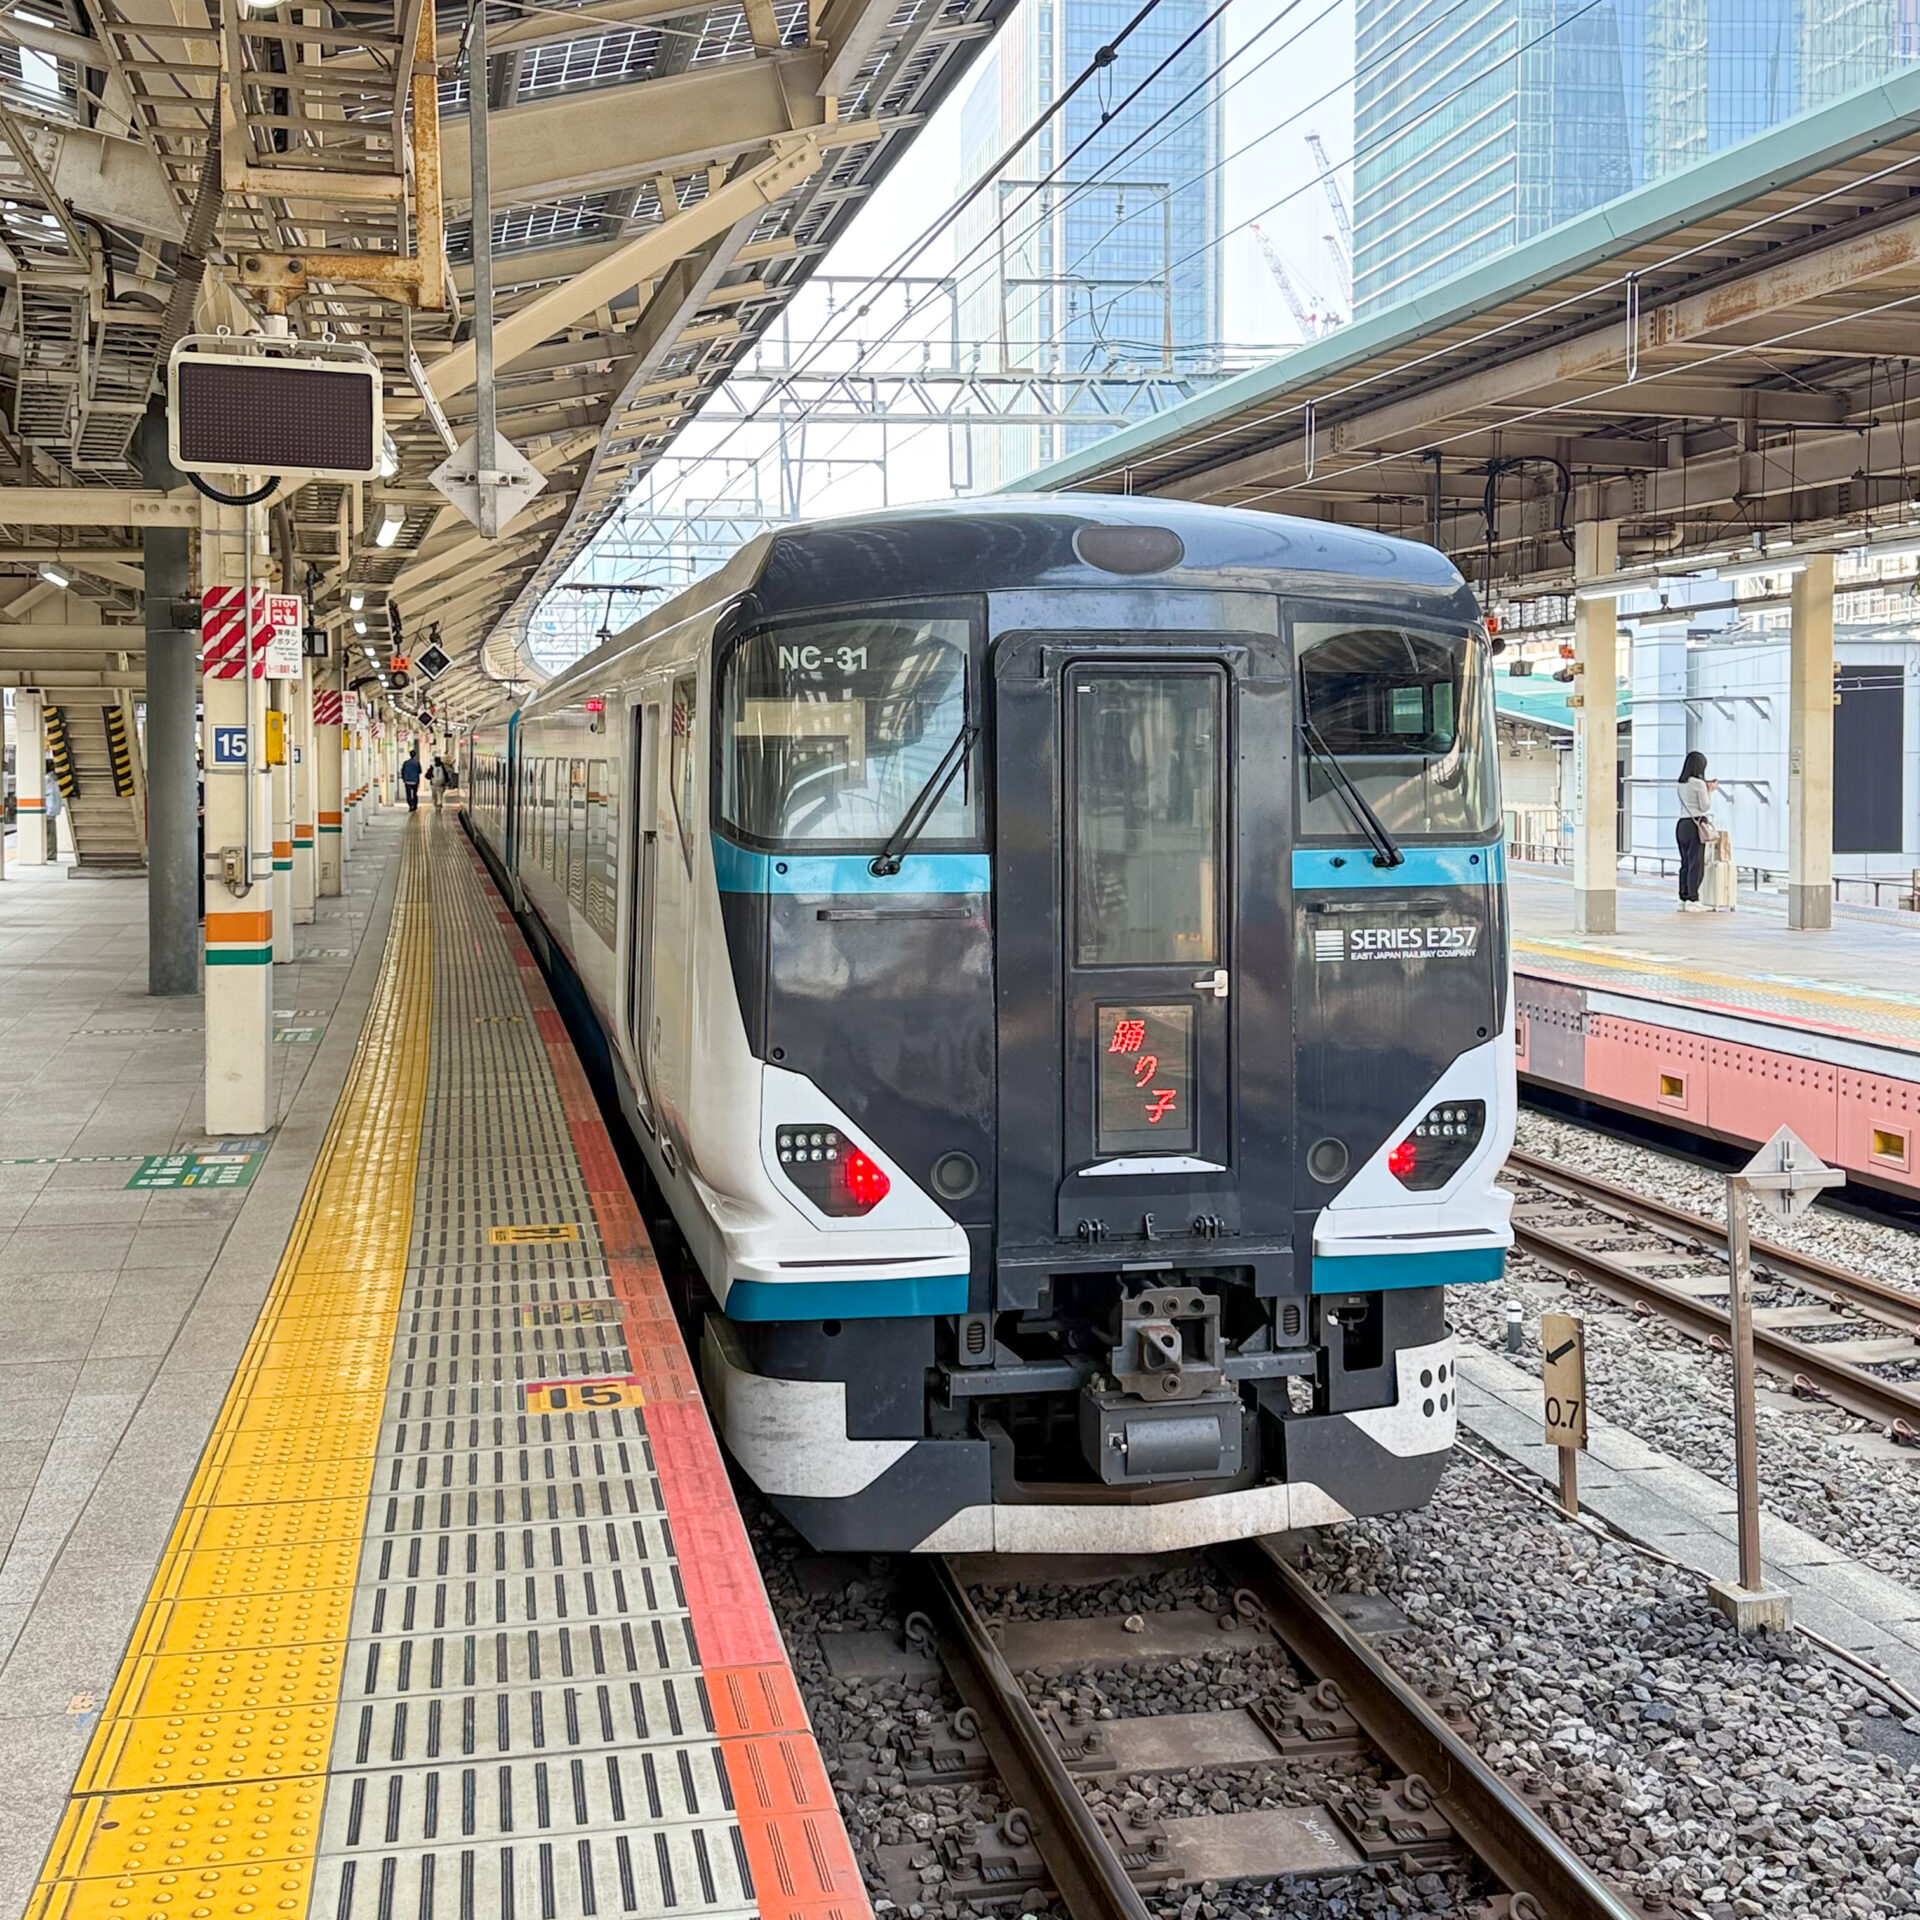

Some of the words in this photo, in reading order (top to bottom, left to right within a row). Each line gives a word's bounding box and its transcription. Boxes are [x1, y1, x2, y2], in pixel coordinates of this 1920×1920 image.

[271, 599, 296, 608] STOP
[277, 637, 298, 646] ボタン
[779, 645, 868, 671] NC-31
[217, 733, 248, 757] 15
[1350, 927, 1422, 950] SERIES
[1426, 926, 1477, 947] E257
[1350, 951, 1373, 961] EAST
[1373, 950, 1401, 960] JAPAN
[1436, 948, 1477, 958] COMPANY
[1108, 1019, 1177, 1124] 踊り子
[1545, 1396, 1580, 1429] 0.7
